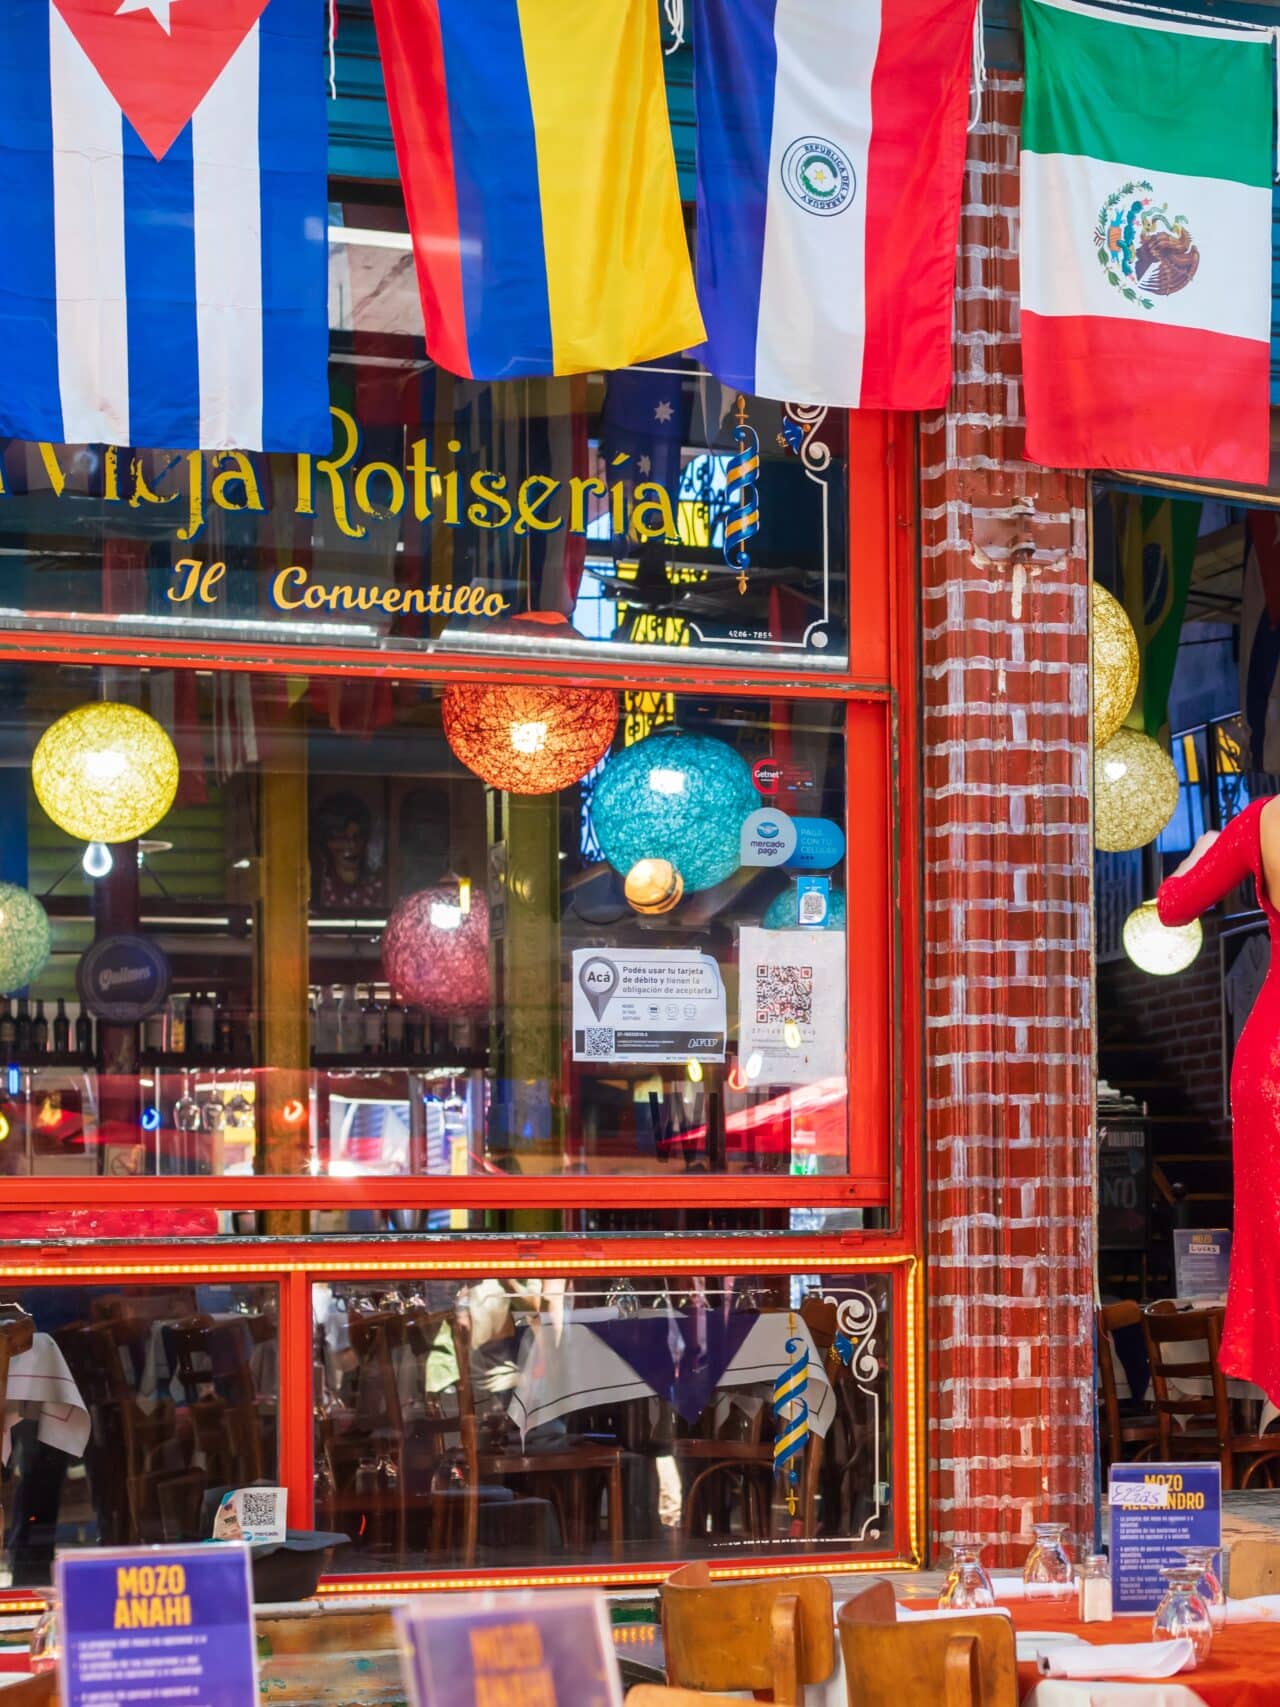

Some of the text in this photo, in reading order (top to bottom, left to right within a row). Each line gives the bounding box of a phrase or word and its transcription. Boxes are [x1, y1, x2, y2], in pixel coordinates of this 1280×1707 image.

[295, 406, 681, 538] Rotisería
[273, 566, 510, 617] Conventillo
[750, 840, 785, 849] mercado
[757, 848, 778, 856] pago
[587, 970, 611, 983] Acá
[622, 966, 704, 976] Podés usar tu tarjeta
[622, 976, 633, 984] de
[634, 975, 658, 984] débito
[622, 986, 662, 995] obligación
[663, 986, 674, 994] de
[1143, 1473, 1184, 1492] MOZO
[116, 1564, 186, 1598] MOZO
[114, 1595, 193, 1630] ANAHI
